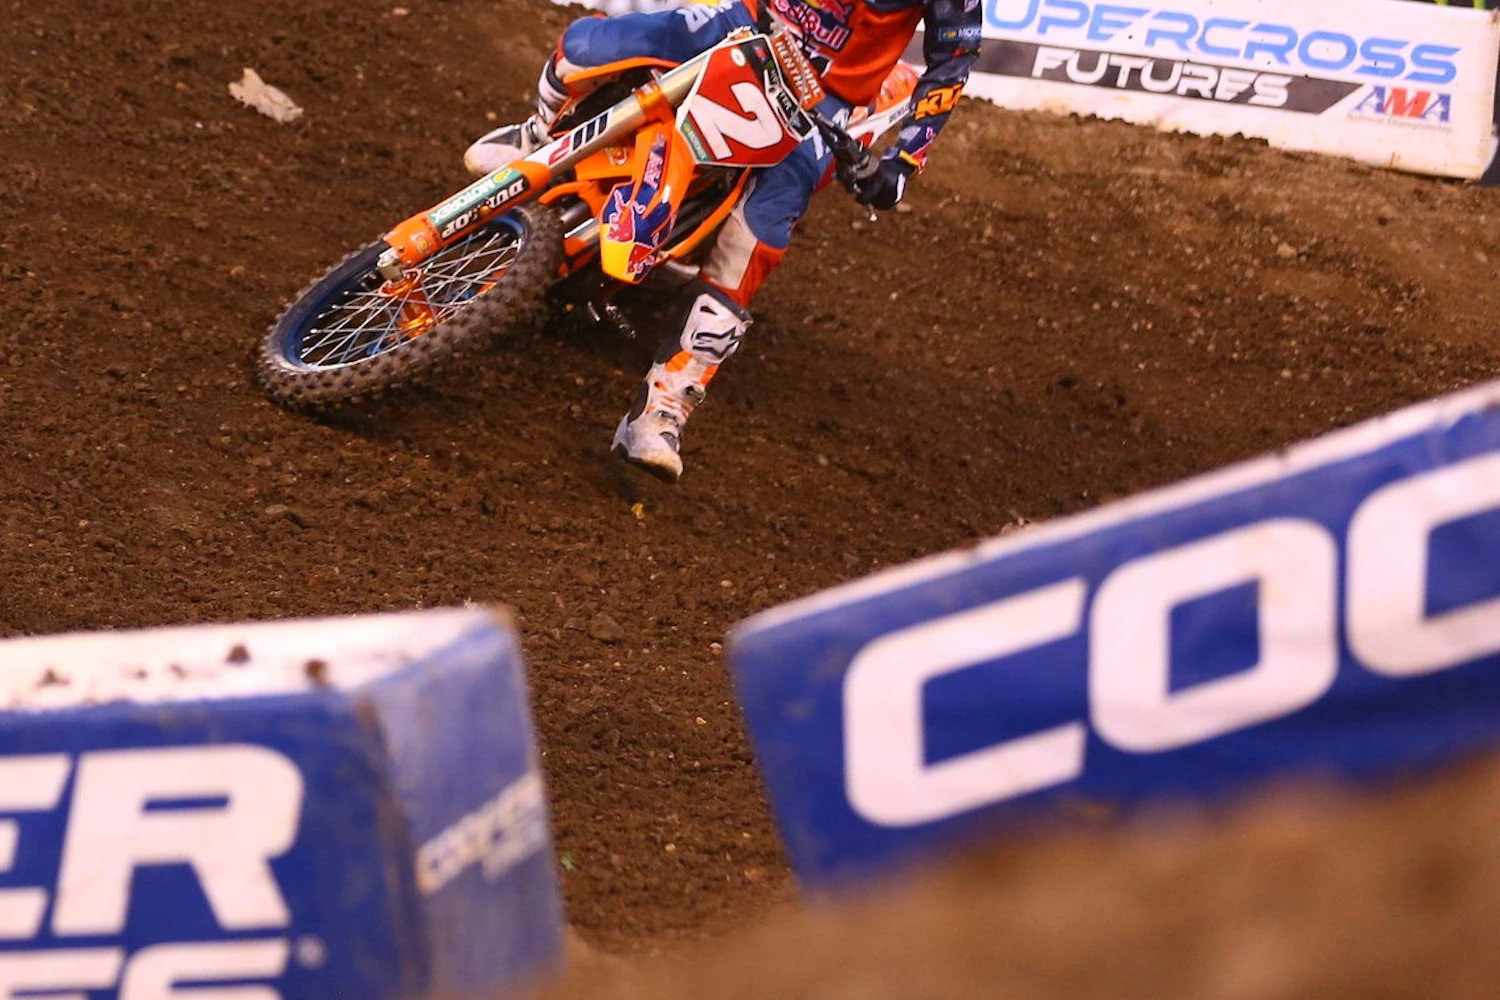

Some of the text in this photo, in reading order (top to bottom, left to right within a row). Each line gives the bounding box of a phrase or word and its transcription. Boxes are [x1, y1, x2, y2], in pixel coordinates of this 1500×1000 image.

[1031, 46, 1292, 107] FUTURES
[689, 81, 783, 161] 2
[1354, 85, 1452, 122] AMA
[430, 179, 497, 223] MOTOREX
